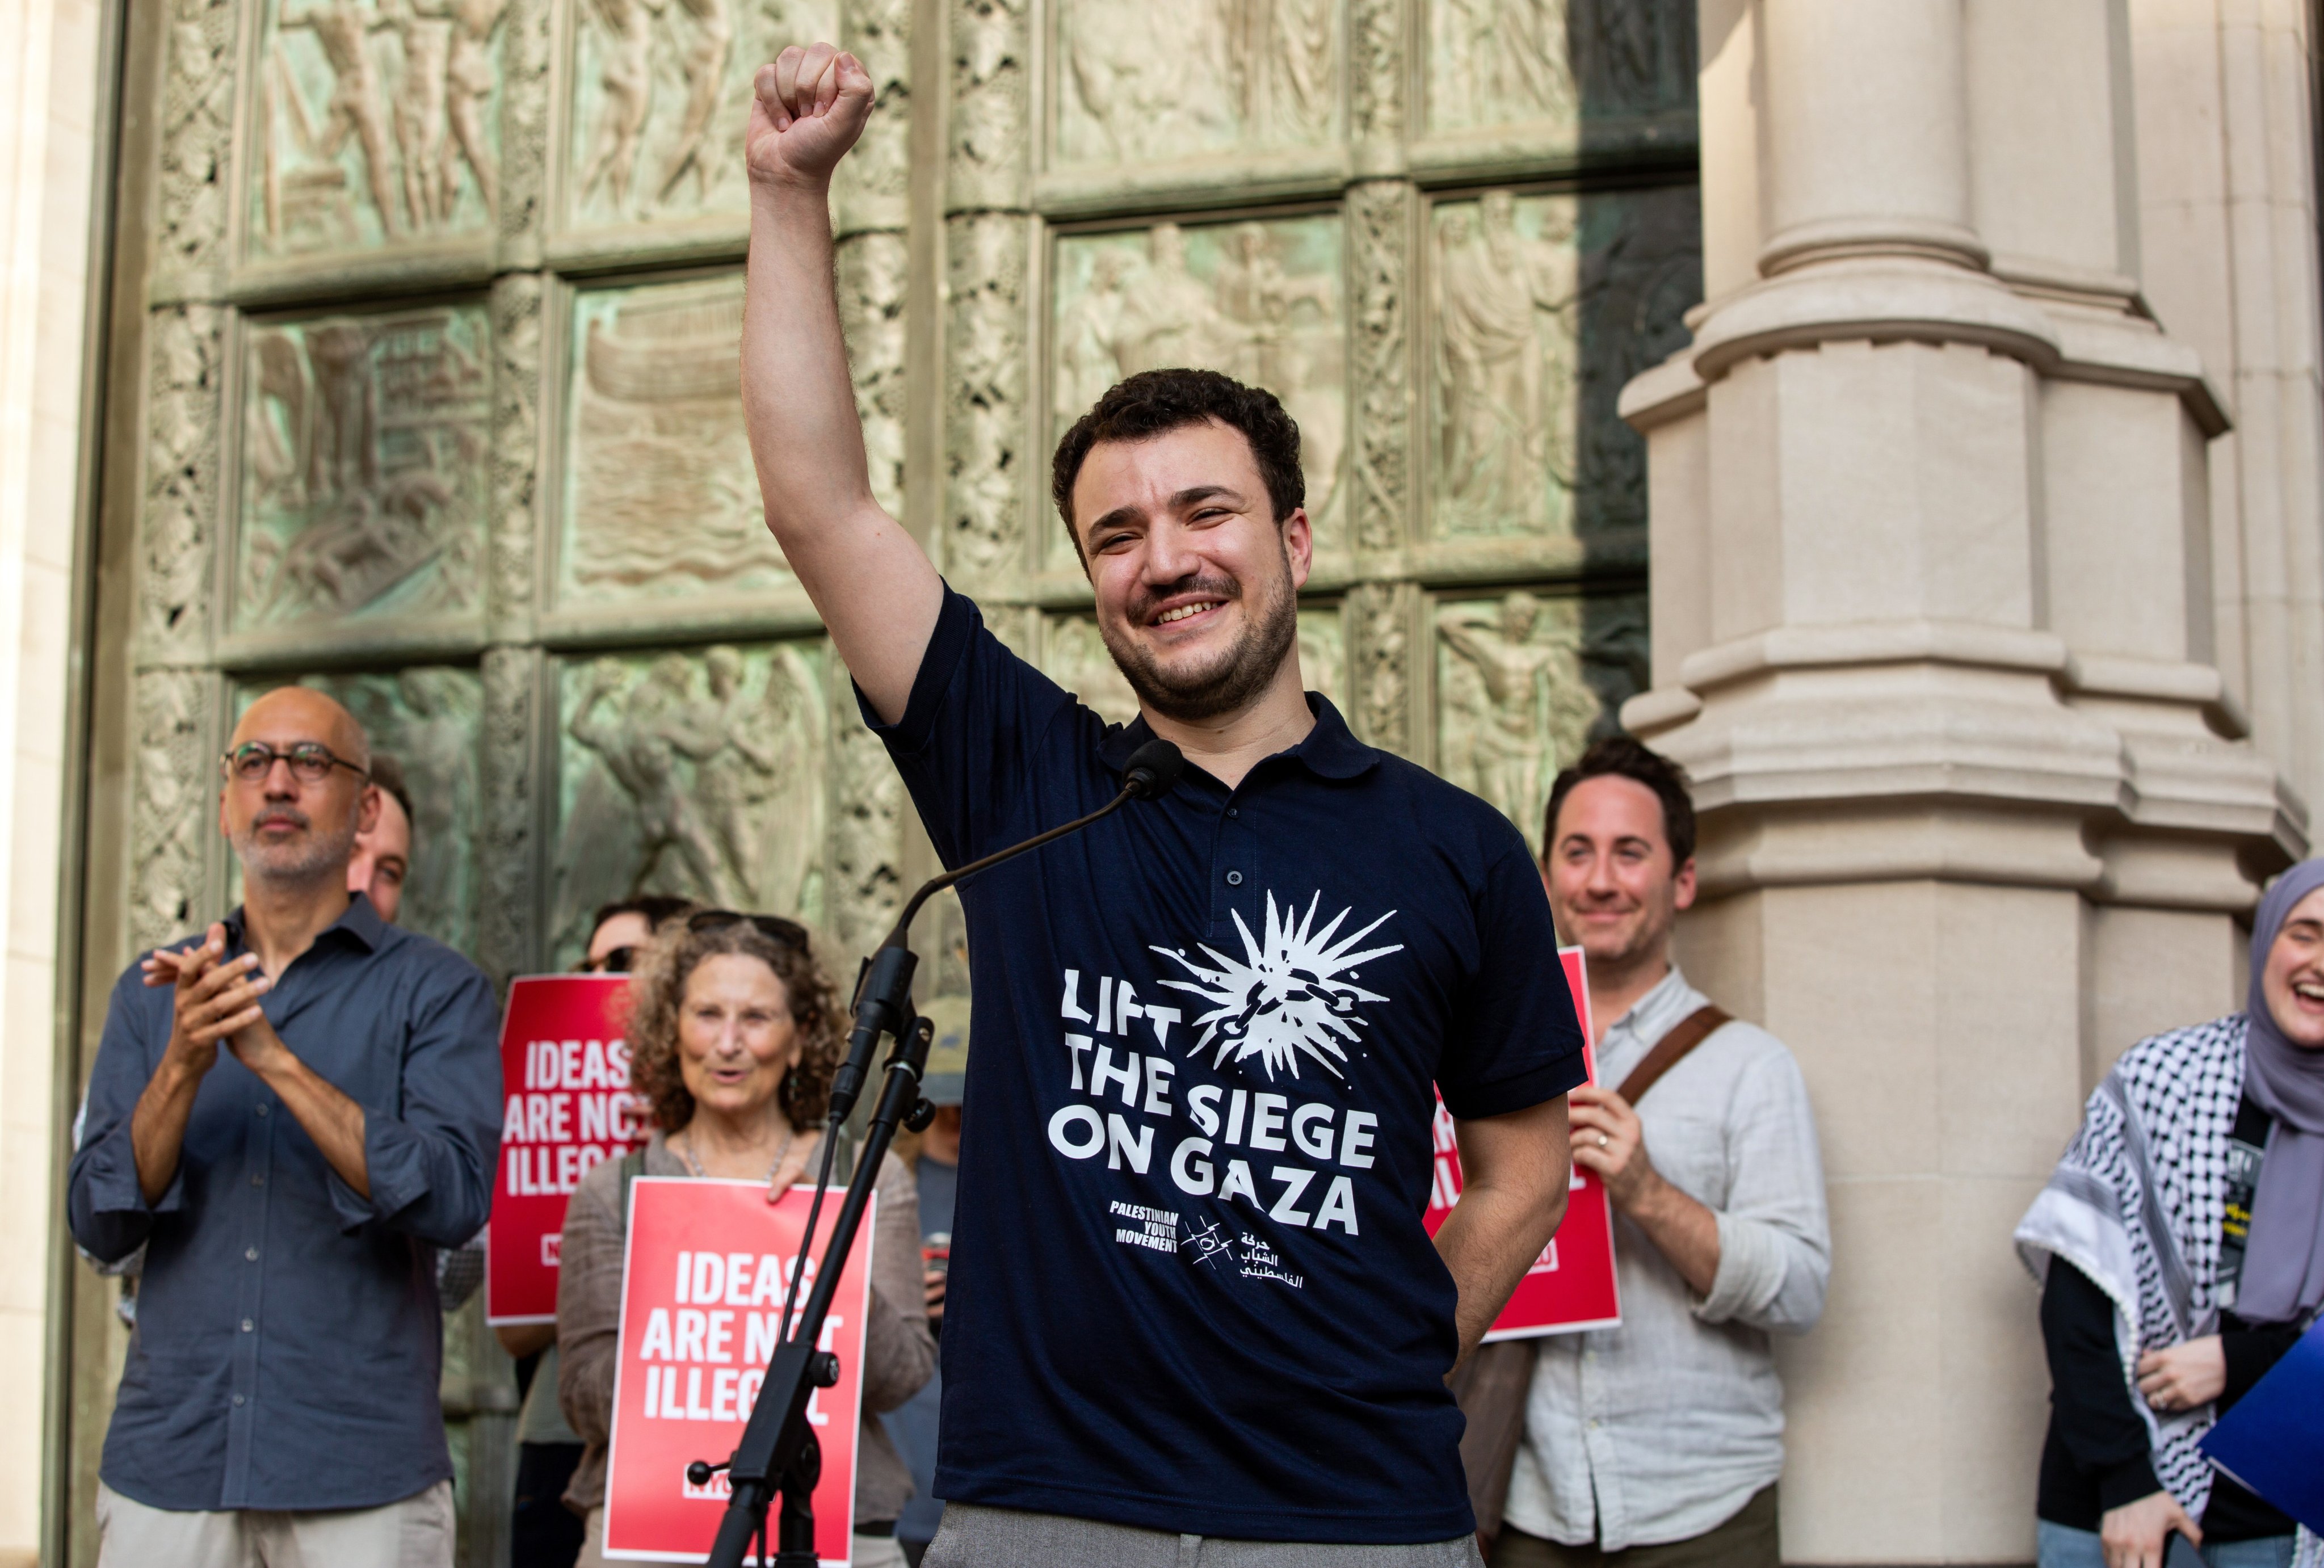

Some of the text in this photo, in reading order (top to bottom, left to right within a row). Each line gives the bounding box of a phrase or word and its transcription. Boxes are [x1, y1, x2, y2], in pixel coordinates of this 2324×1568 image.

[1061, 968, 1182, 1052] LIFT
[525, 1039, 633, 1090] IDEAS
[502, 1091, 650, 1144] ARE NO
[1065, 1032, 1175, 1117] THE
[1187, 1084, 1379, 1170] SIEGE
[1048, 1104, 1155, 1174] ON
[1170, 1137, 1359, 1237] GAZA
[1110, 1200, 1179, 1226] PALESTINIAN
[1145, 1221, 1176, 1239] YOUTH
[1116, 1229, 1178, 1253] MOVEMENT
[1241, 1231, 1270, 1250] حركة
[1241, 1248, 1278, 1267] الشباب
[675, 1251, 817, 1309] IDEAS
[1239, 1264, 1303, 1289] الفلسطيني
[640, 1308, 844, 1365] ARE NT
[644, 1365, 829, 1426] ILLEGL
